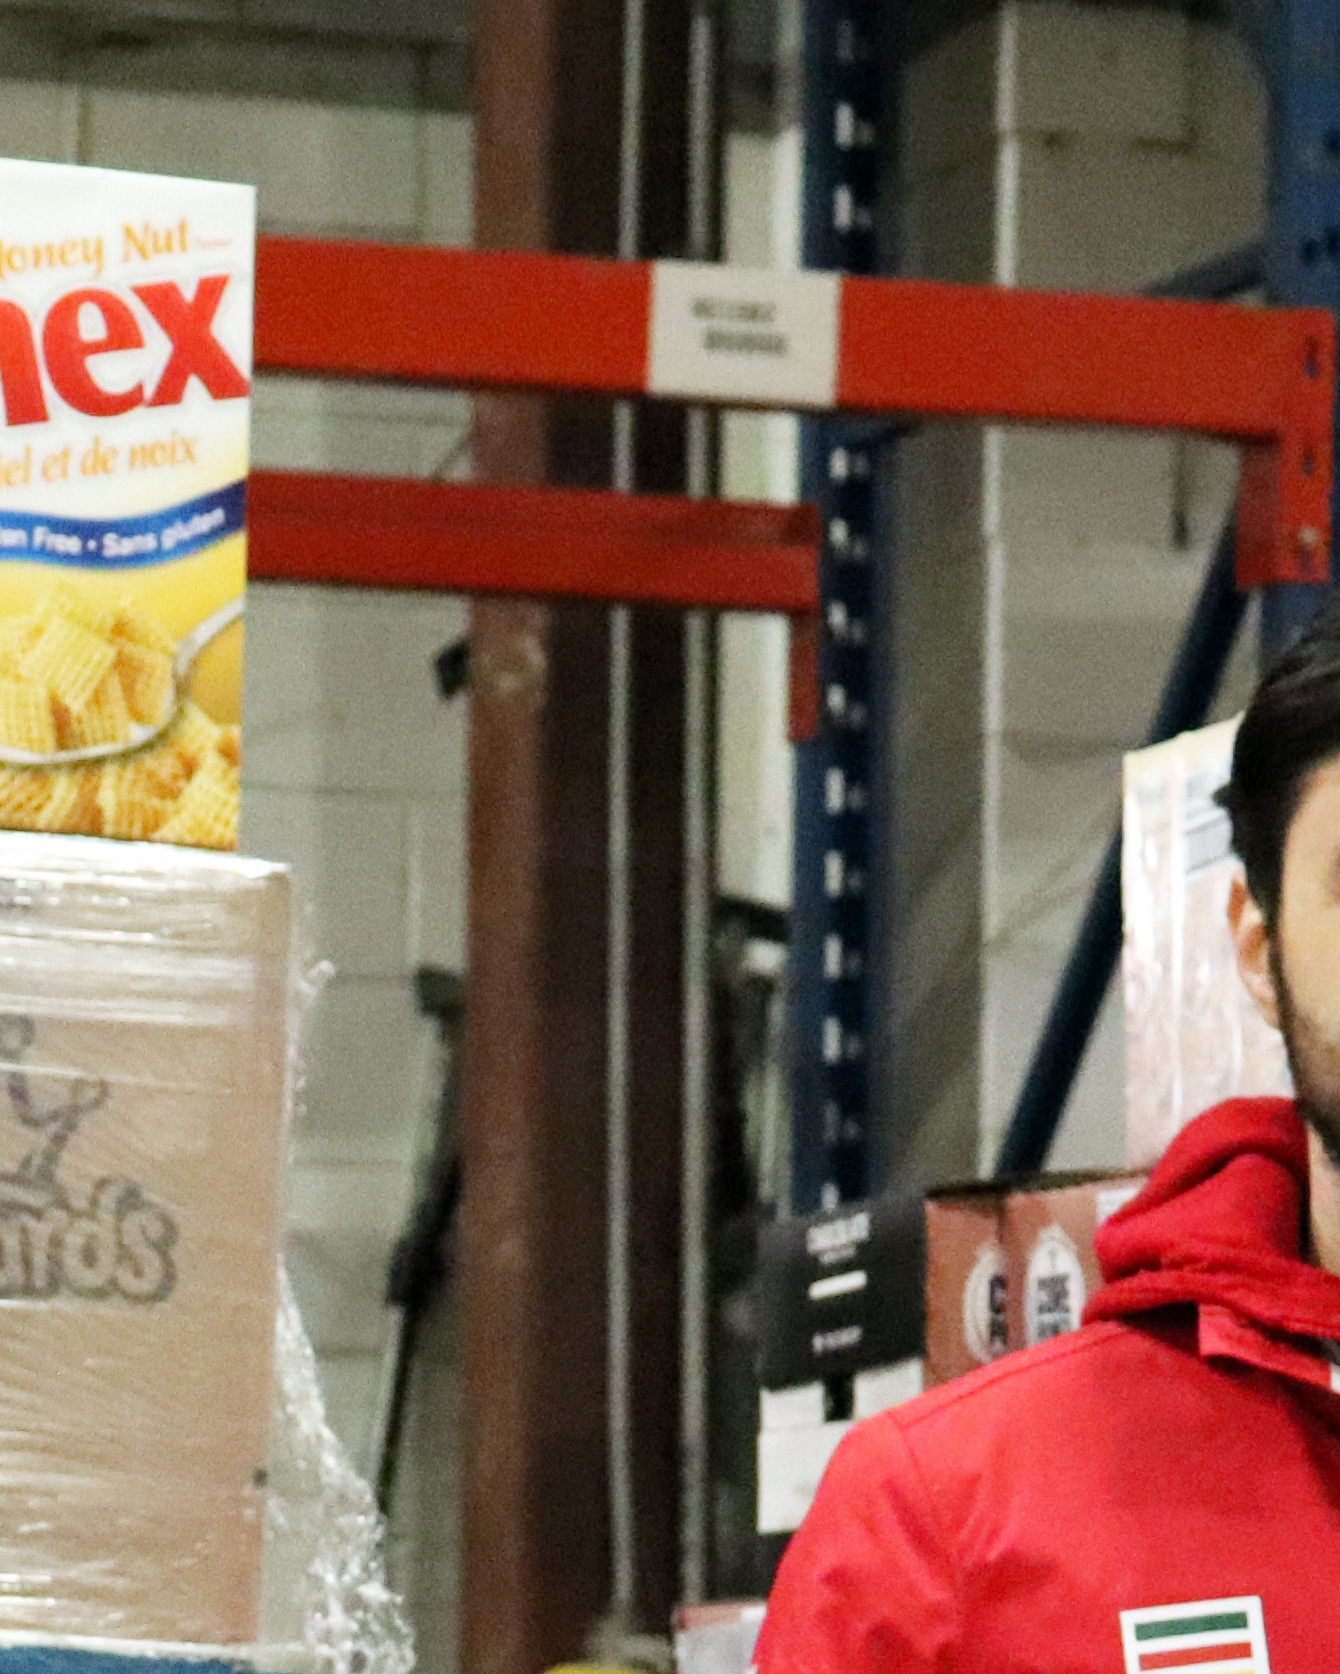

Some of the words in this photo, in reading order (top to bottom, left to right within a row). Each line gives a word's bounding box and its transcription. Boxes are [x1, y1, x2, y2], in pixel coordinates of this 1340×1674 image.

[0, 235, 105, 281] oney
[122, 217, 189, 263] Nut
[0, 443, 32, 487] el
[81, 436, 119, 478] de
[129, 430, 197, 471] noix
[33, 526, 83, 555] Free
[102, 532, 159, 559] Sans
[161, 507, 226, 550] gluten
